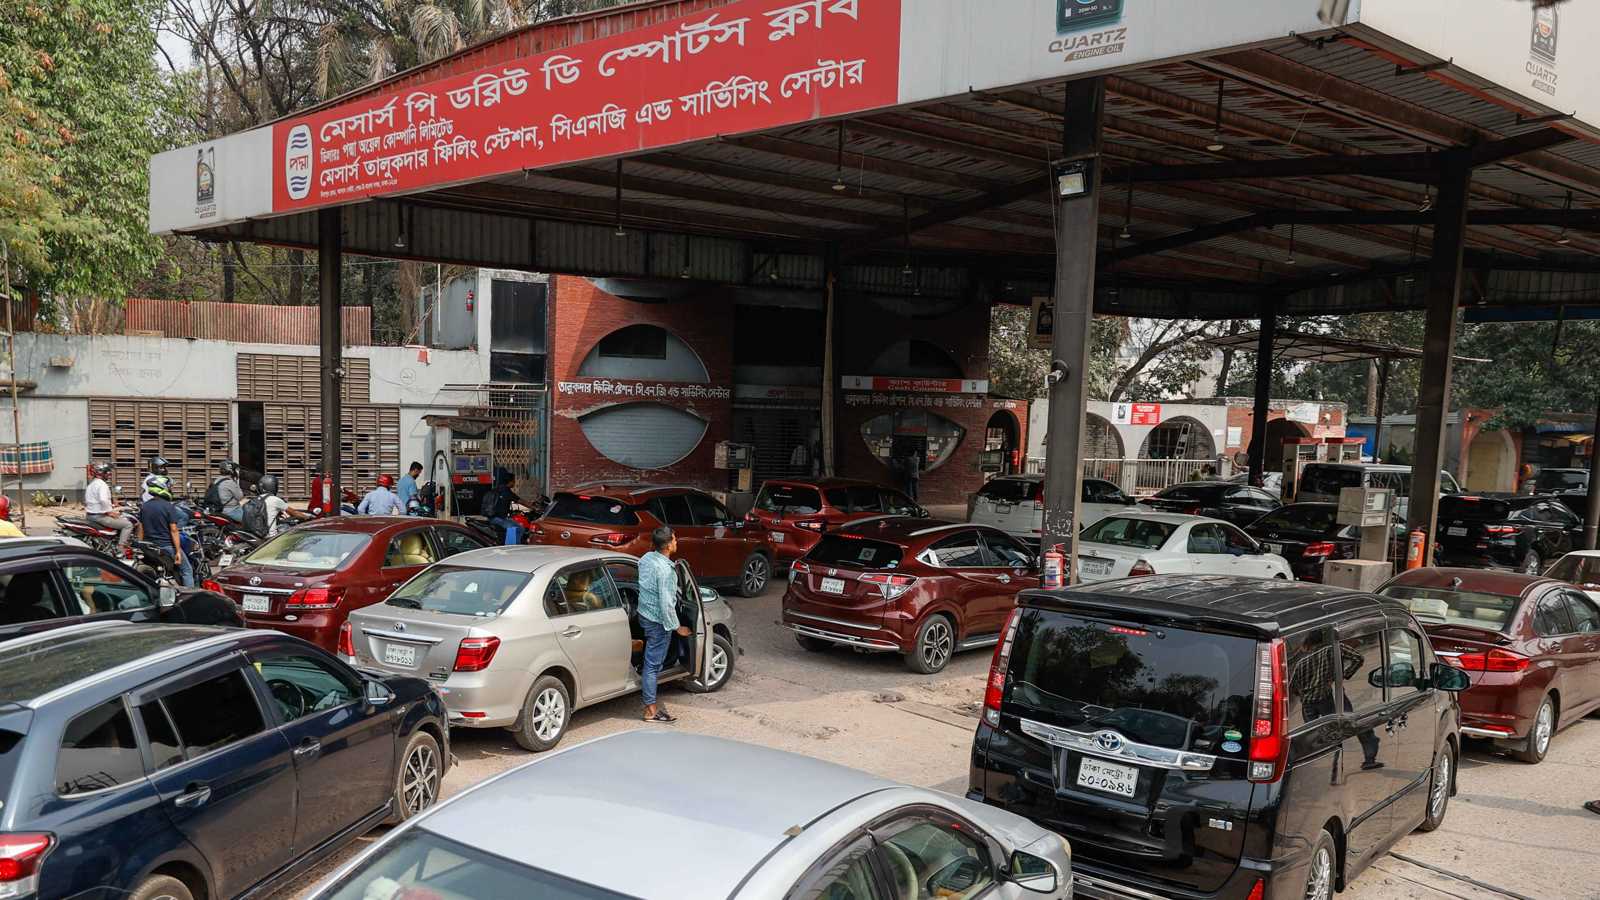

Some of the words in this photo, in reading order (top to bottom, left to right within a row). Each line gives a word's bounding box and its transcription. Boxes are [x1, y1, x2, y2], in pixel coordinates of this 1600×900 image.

[1048, 27, 1128, 53] QUARTZ
[1073, 47, 1105, 60] ENGINE
[1106, 44, 1121, 54] OIL
[320, 97, 399, 142] মেসার্স
[404, 92, 437, 123] পি
[446, 68, 531, 108] ডব্লিউ
[540, 55, 583, 90] ডি
[598, 13, 751, 77] স্পোর্টস
[762, 0, 859, 42] ক্লাব
[1525, 61, 1558, 86] QUARTZ
[320, 155, 361, 187] মেসার্স
[363, 148, 429, 178] তালুকদার
[433, 135, 480, 166] ফিলিং
[550, 103, 627, 143] সিএনজি
[635, 99, 672, 126] এন্ড
[679, 75, 772, 117] সার্ভিসিং
[780, 58, 867, 98] সেন্টার
[1082, 763, 1101, 773] ঢাকা
[1080, 773, 1133, 794] ২০-০৯৪৬
